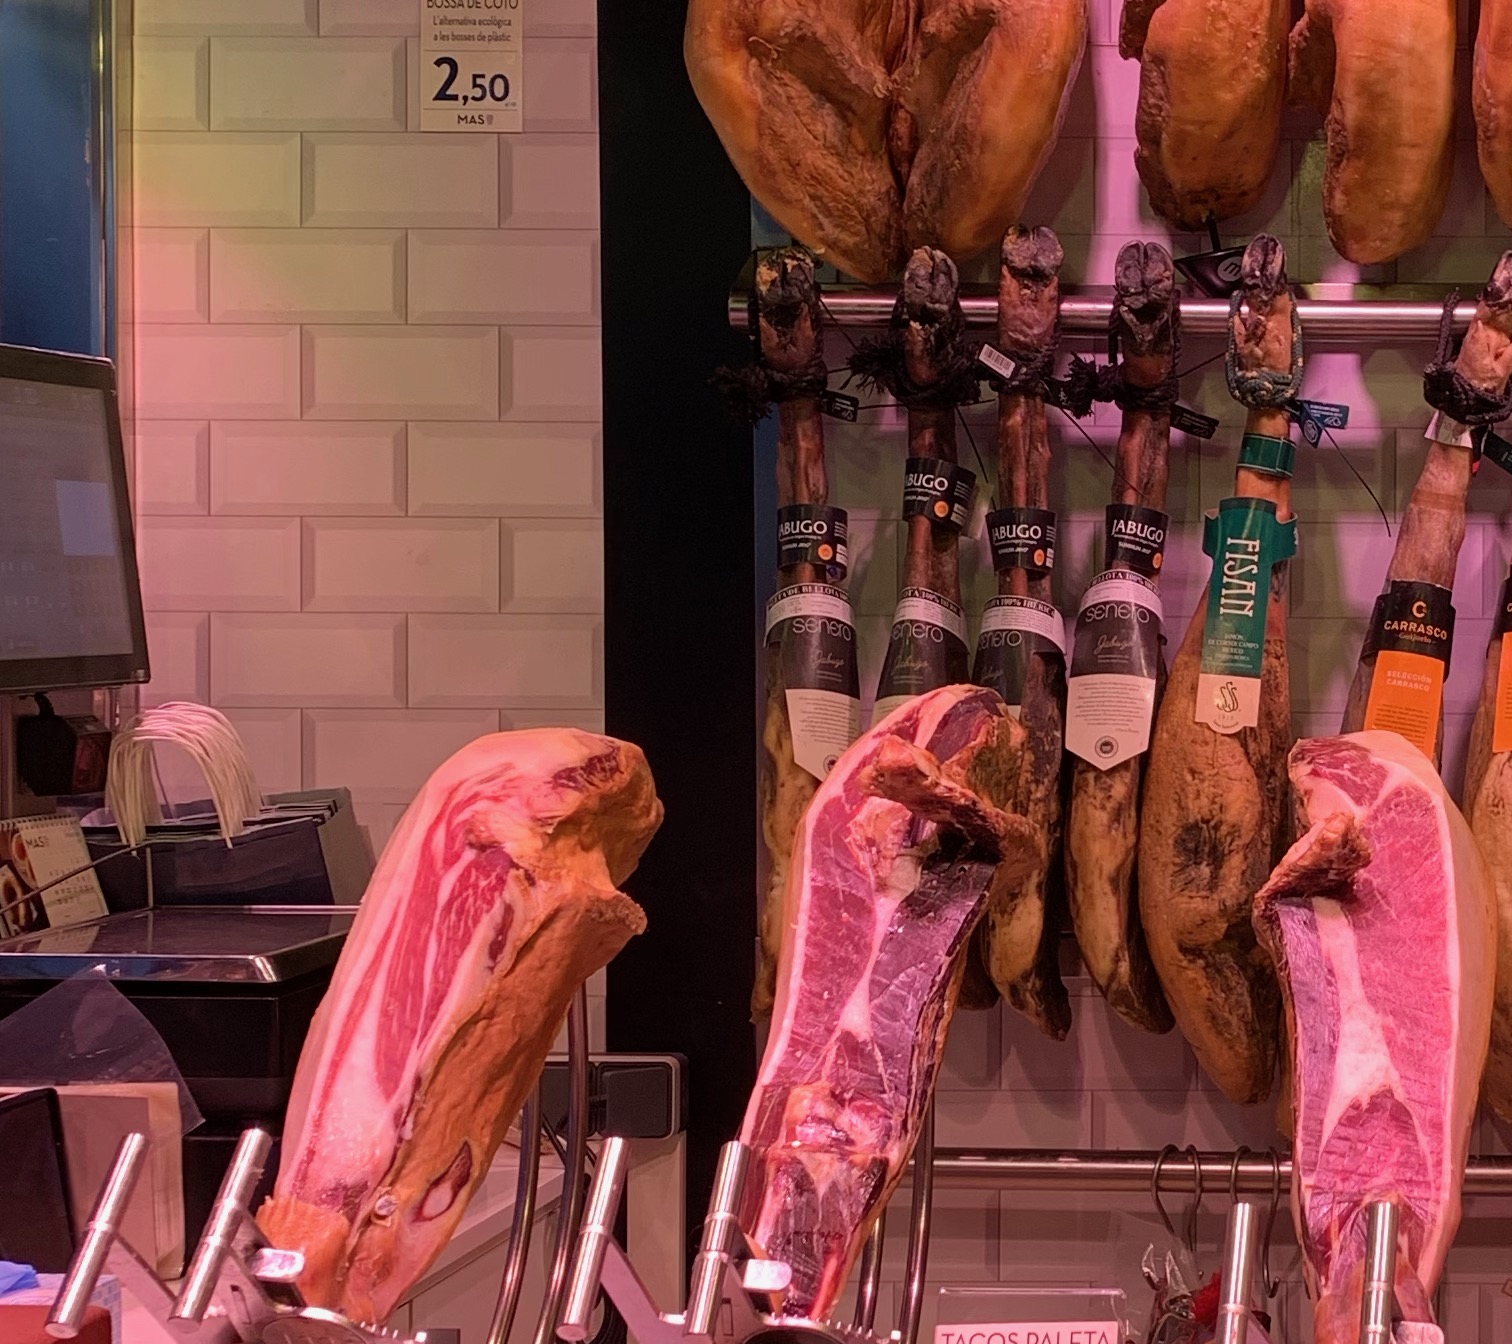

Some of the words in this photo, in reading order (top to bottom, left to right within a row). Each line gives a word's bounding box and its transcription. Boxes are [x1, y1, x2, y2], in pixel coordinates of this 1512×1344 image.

[432, 57, 509, 106] 2,50
[457, 114, 485, 125] MAS
[1111, 518, 1164, 543] JABUGO
[1219, 537, 1260, 617] FISAN
[1383, 619, 1448, 641] CARRASCO
